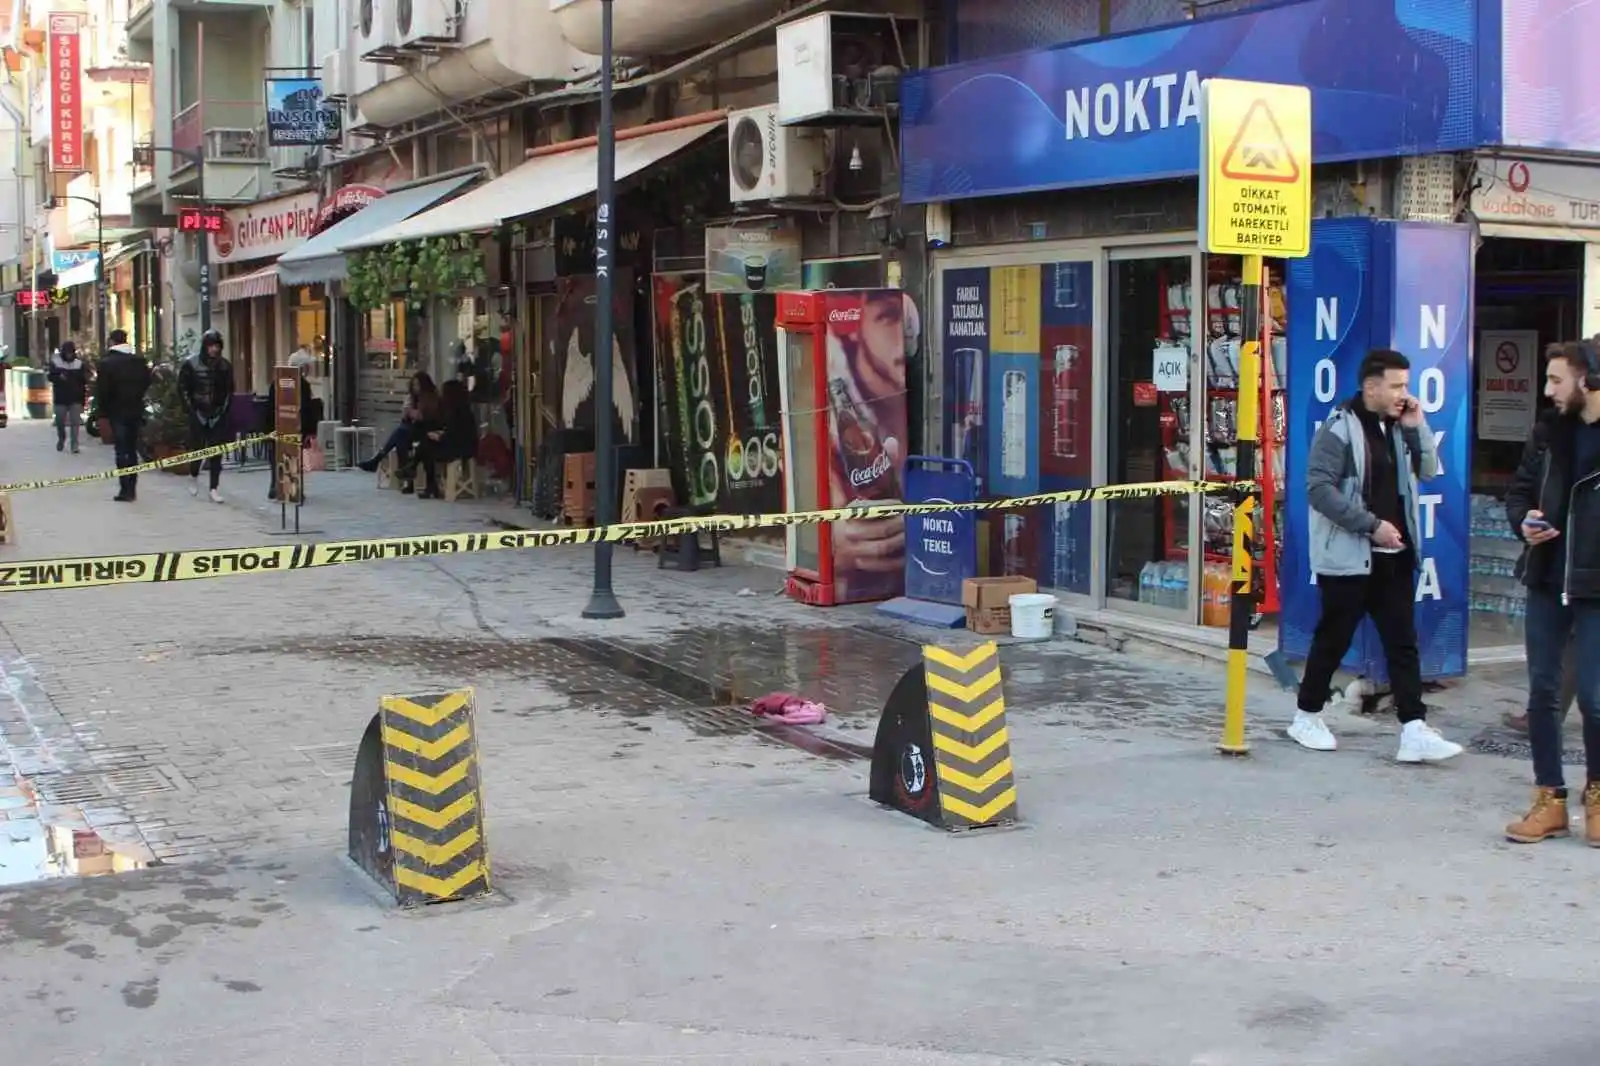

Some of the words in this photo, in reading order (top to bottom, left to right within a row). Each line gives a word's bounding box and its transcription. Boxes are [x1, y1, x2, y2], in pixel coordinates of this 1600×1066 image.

[1064, 69, 1201, 141] NOKTA
[60, 108, 73, 164] KURSU
[1240, 186, 1281, 200] DİKKAT
[1232, 202, 1287, 215] OTOMATİK
[1482, 195, 1557, 217] vodafone
[287, 202, 315, 239] PİDE
[1236, 231, 1283, 246] BARİYER
[956, 286, 980, 301] FARKLI
[1158, 361, 1181, 378] AÇIK
[850, 451, 892, 486] Coca-Cola
[922, 518, 954, 534] NOKTA
[923, 538, 953, 554] TEKEL
